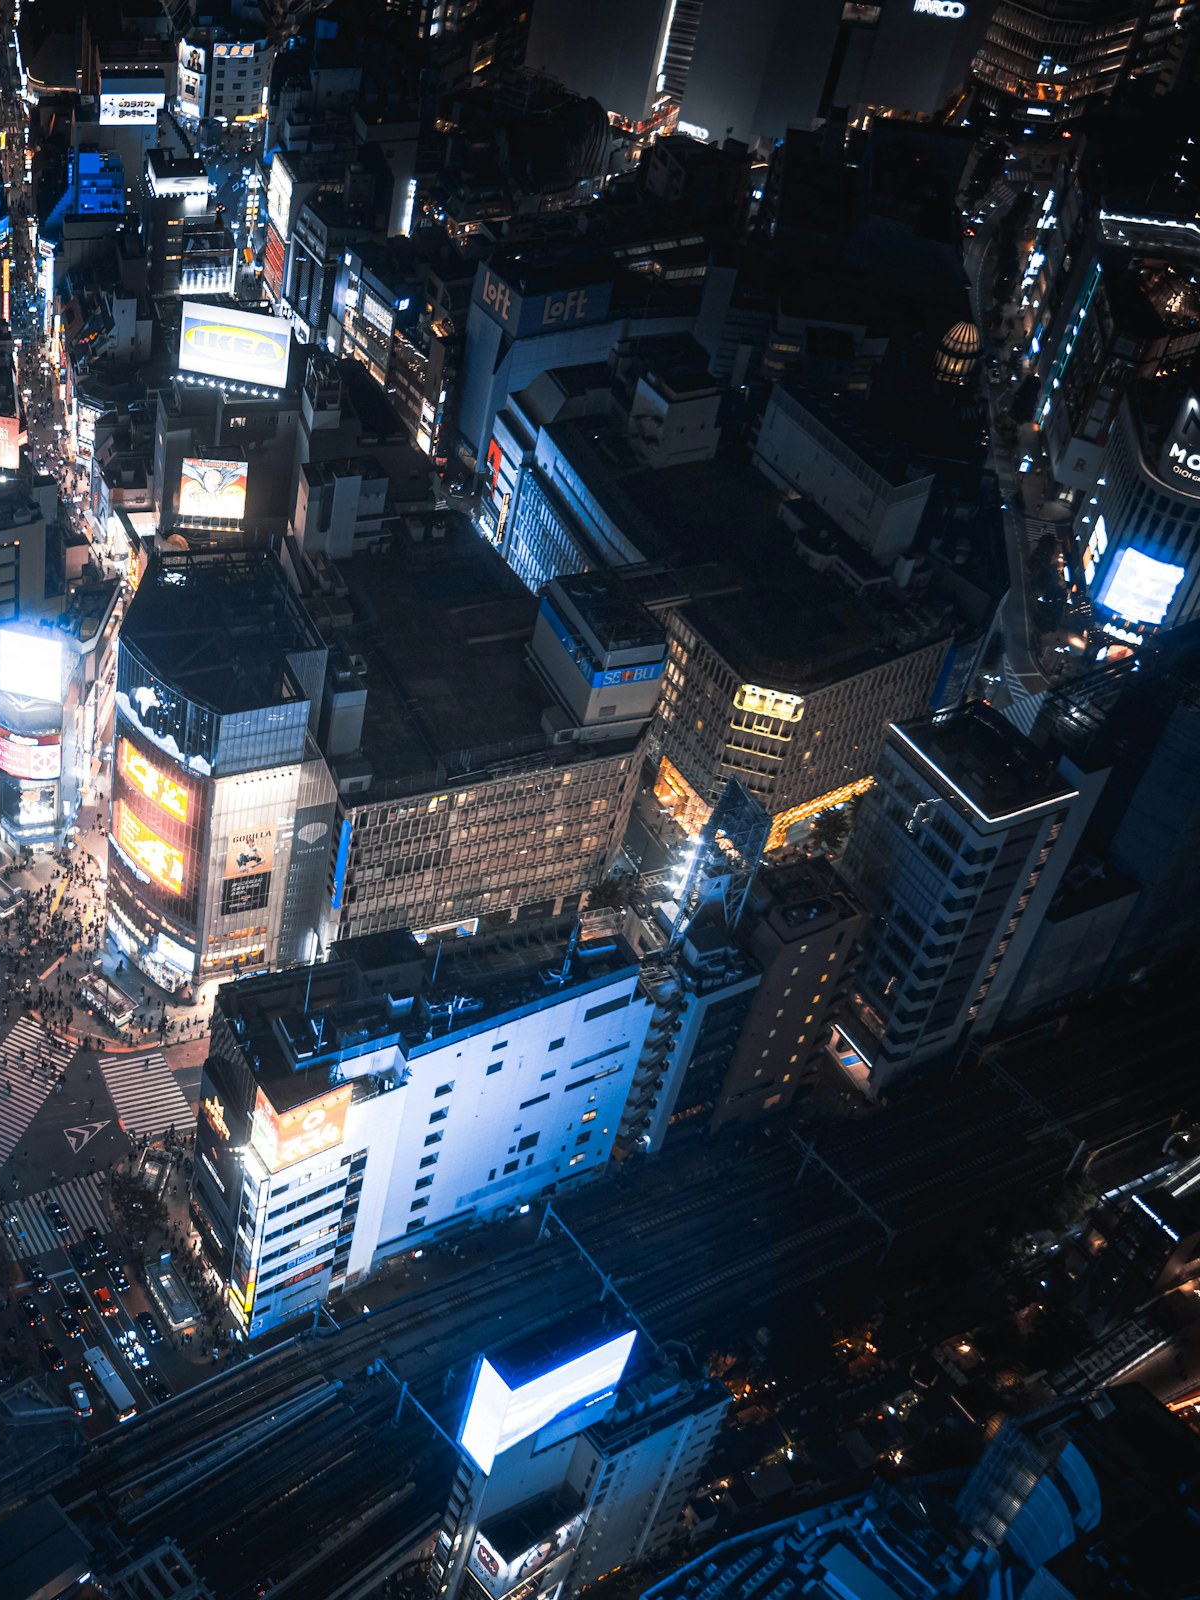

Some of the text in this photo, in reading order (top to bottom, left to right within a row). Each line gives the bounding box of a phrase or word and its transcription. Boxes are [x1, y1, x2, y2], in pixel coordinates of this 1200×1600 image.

[194, 330, 277, 360] IKEA
[232, 830, 272, 844] GORILLA
[297, 845, 326, 855] TSUTAYA
